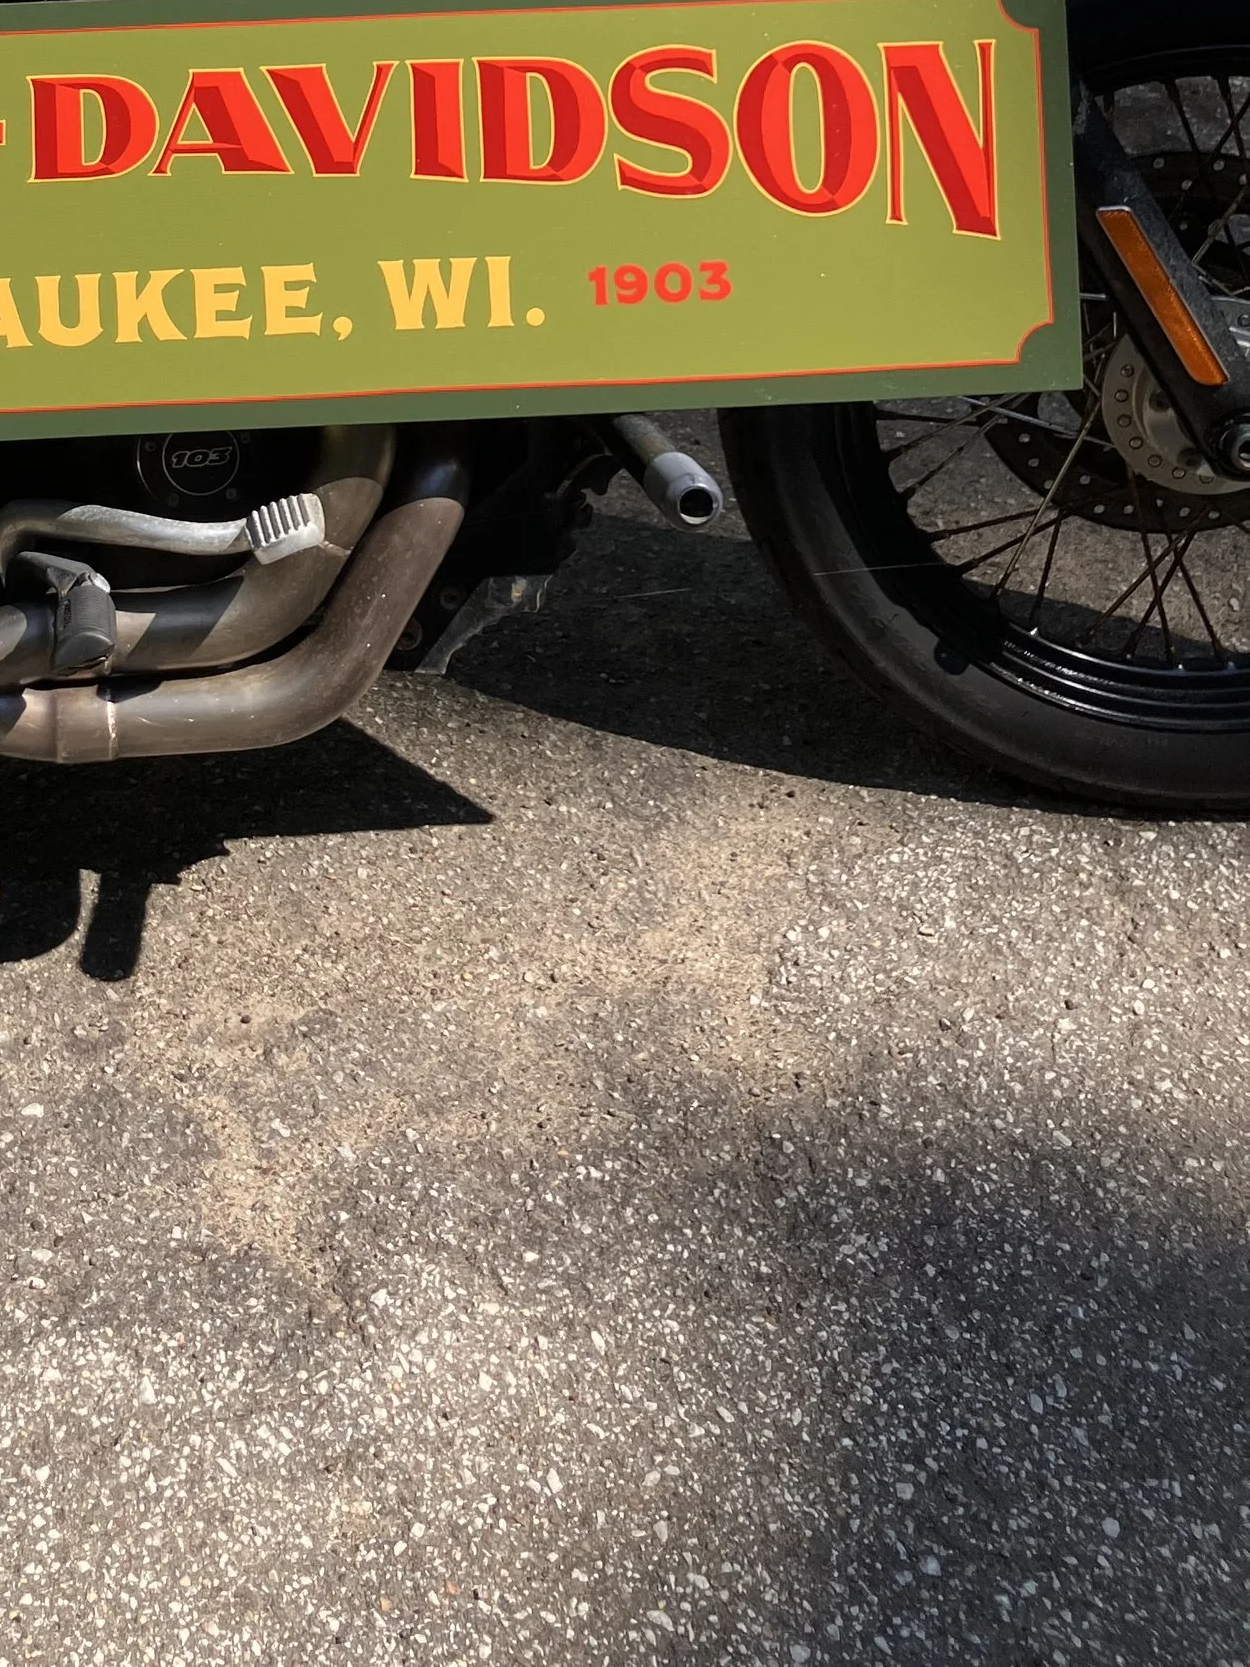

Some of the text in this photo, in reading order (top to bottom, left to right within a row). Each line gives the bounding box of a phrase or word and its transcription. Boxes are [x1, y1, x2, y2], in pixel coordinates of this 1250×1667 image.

[377, 256, 545, 330] WI.
[586, 258, 734, 307] 1903
[171, 446, 233, 468] 103
